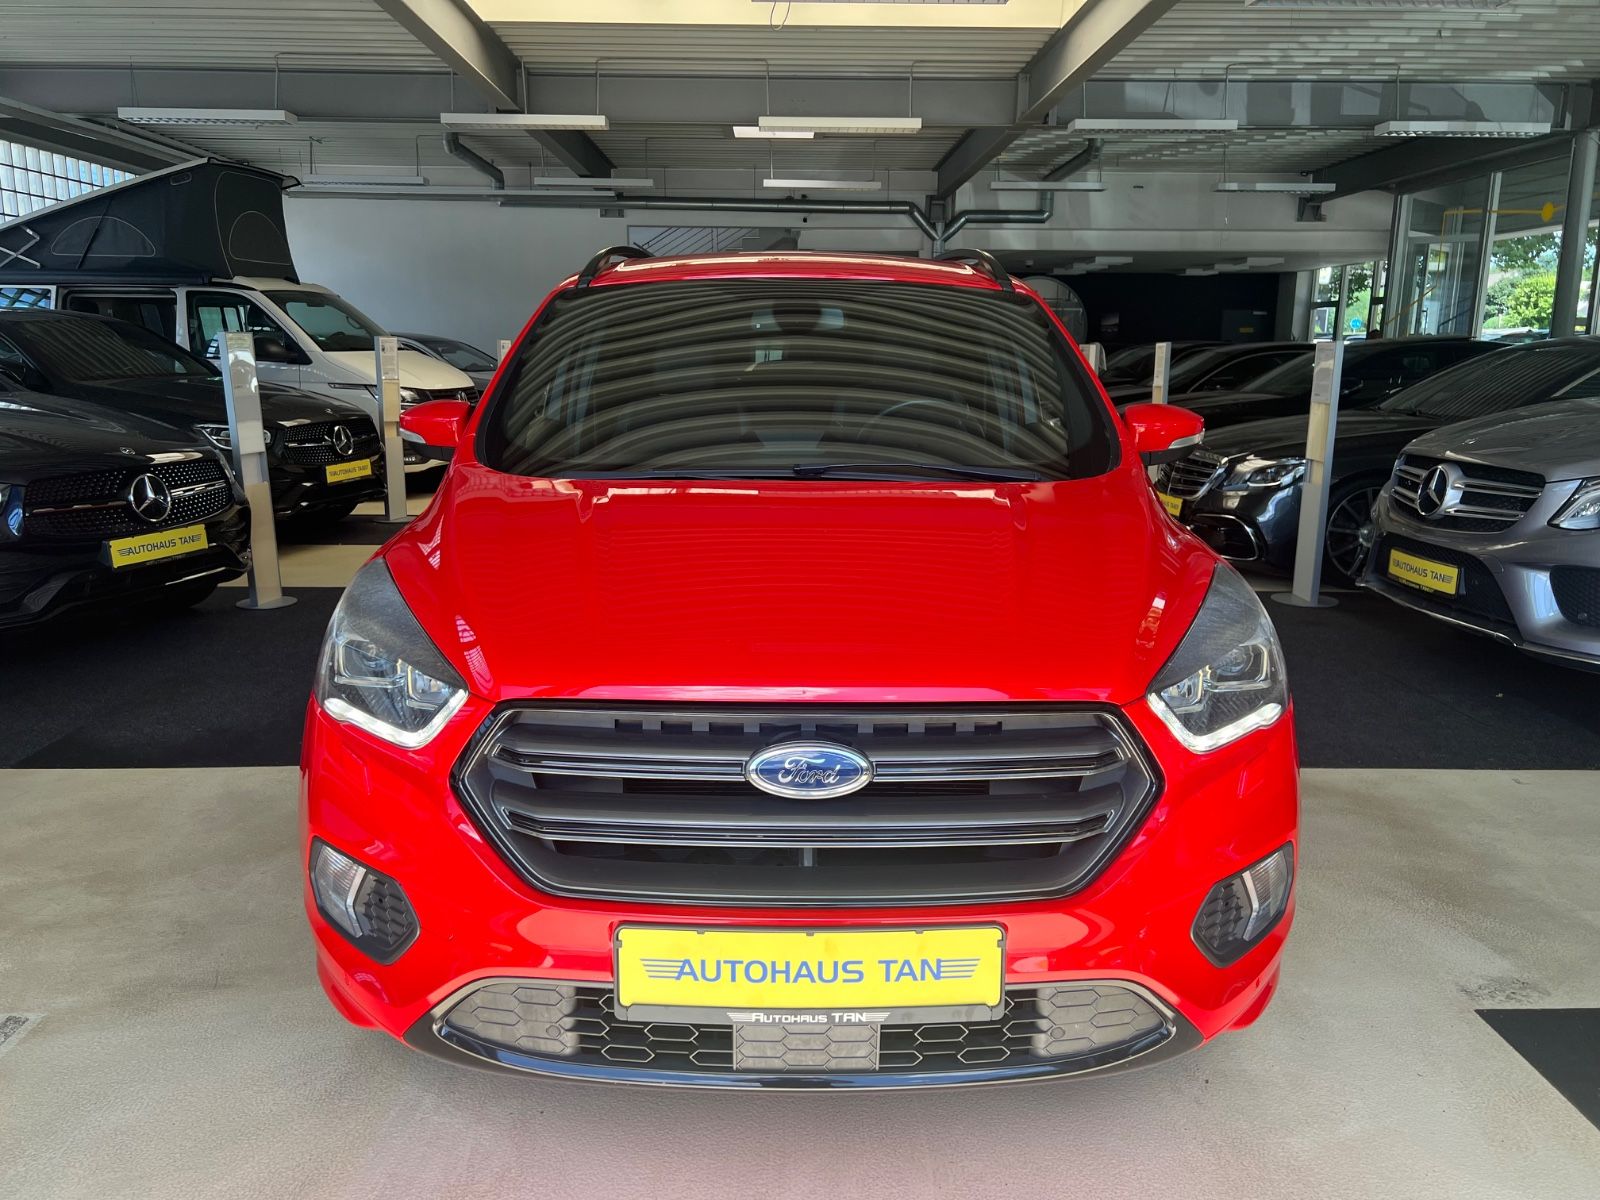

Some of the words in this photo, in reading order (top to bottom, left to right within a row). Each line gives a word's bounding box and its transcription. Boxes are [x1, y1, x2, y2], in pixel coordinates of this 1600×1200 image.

[128, 539, 177, 555] AUTOHAUS
[179, 535, 195, 545] TAN
[1397, 560, 1428, 578] AUTOHAUS
[1430, 570, 1444, 582] TAN
[778, 756, 841, 784] Ford
[675, 958, 864, 983] AUTOHAUS
[878, 958, 942, 982] TAN
[831, 1012, 867, 1023] TAN
